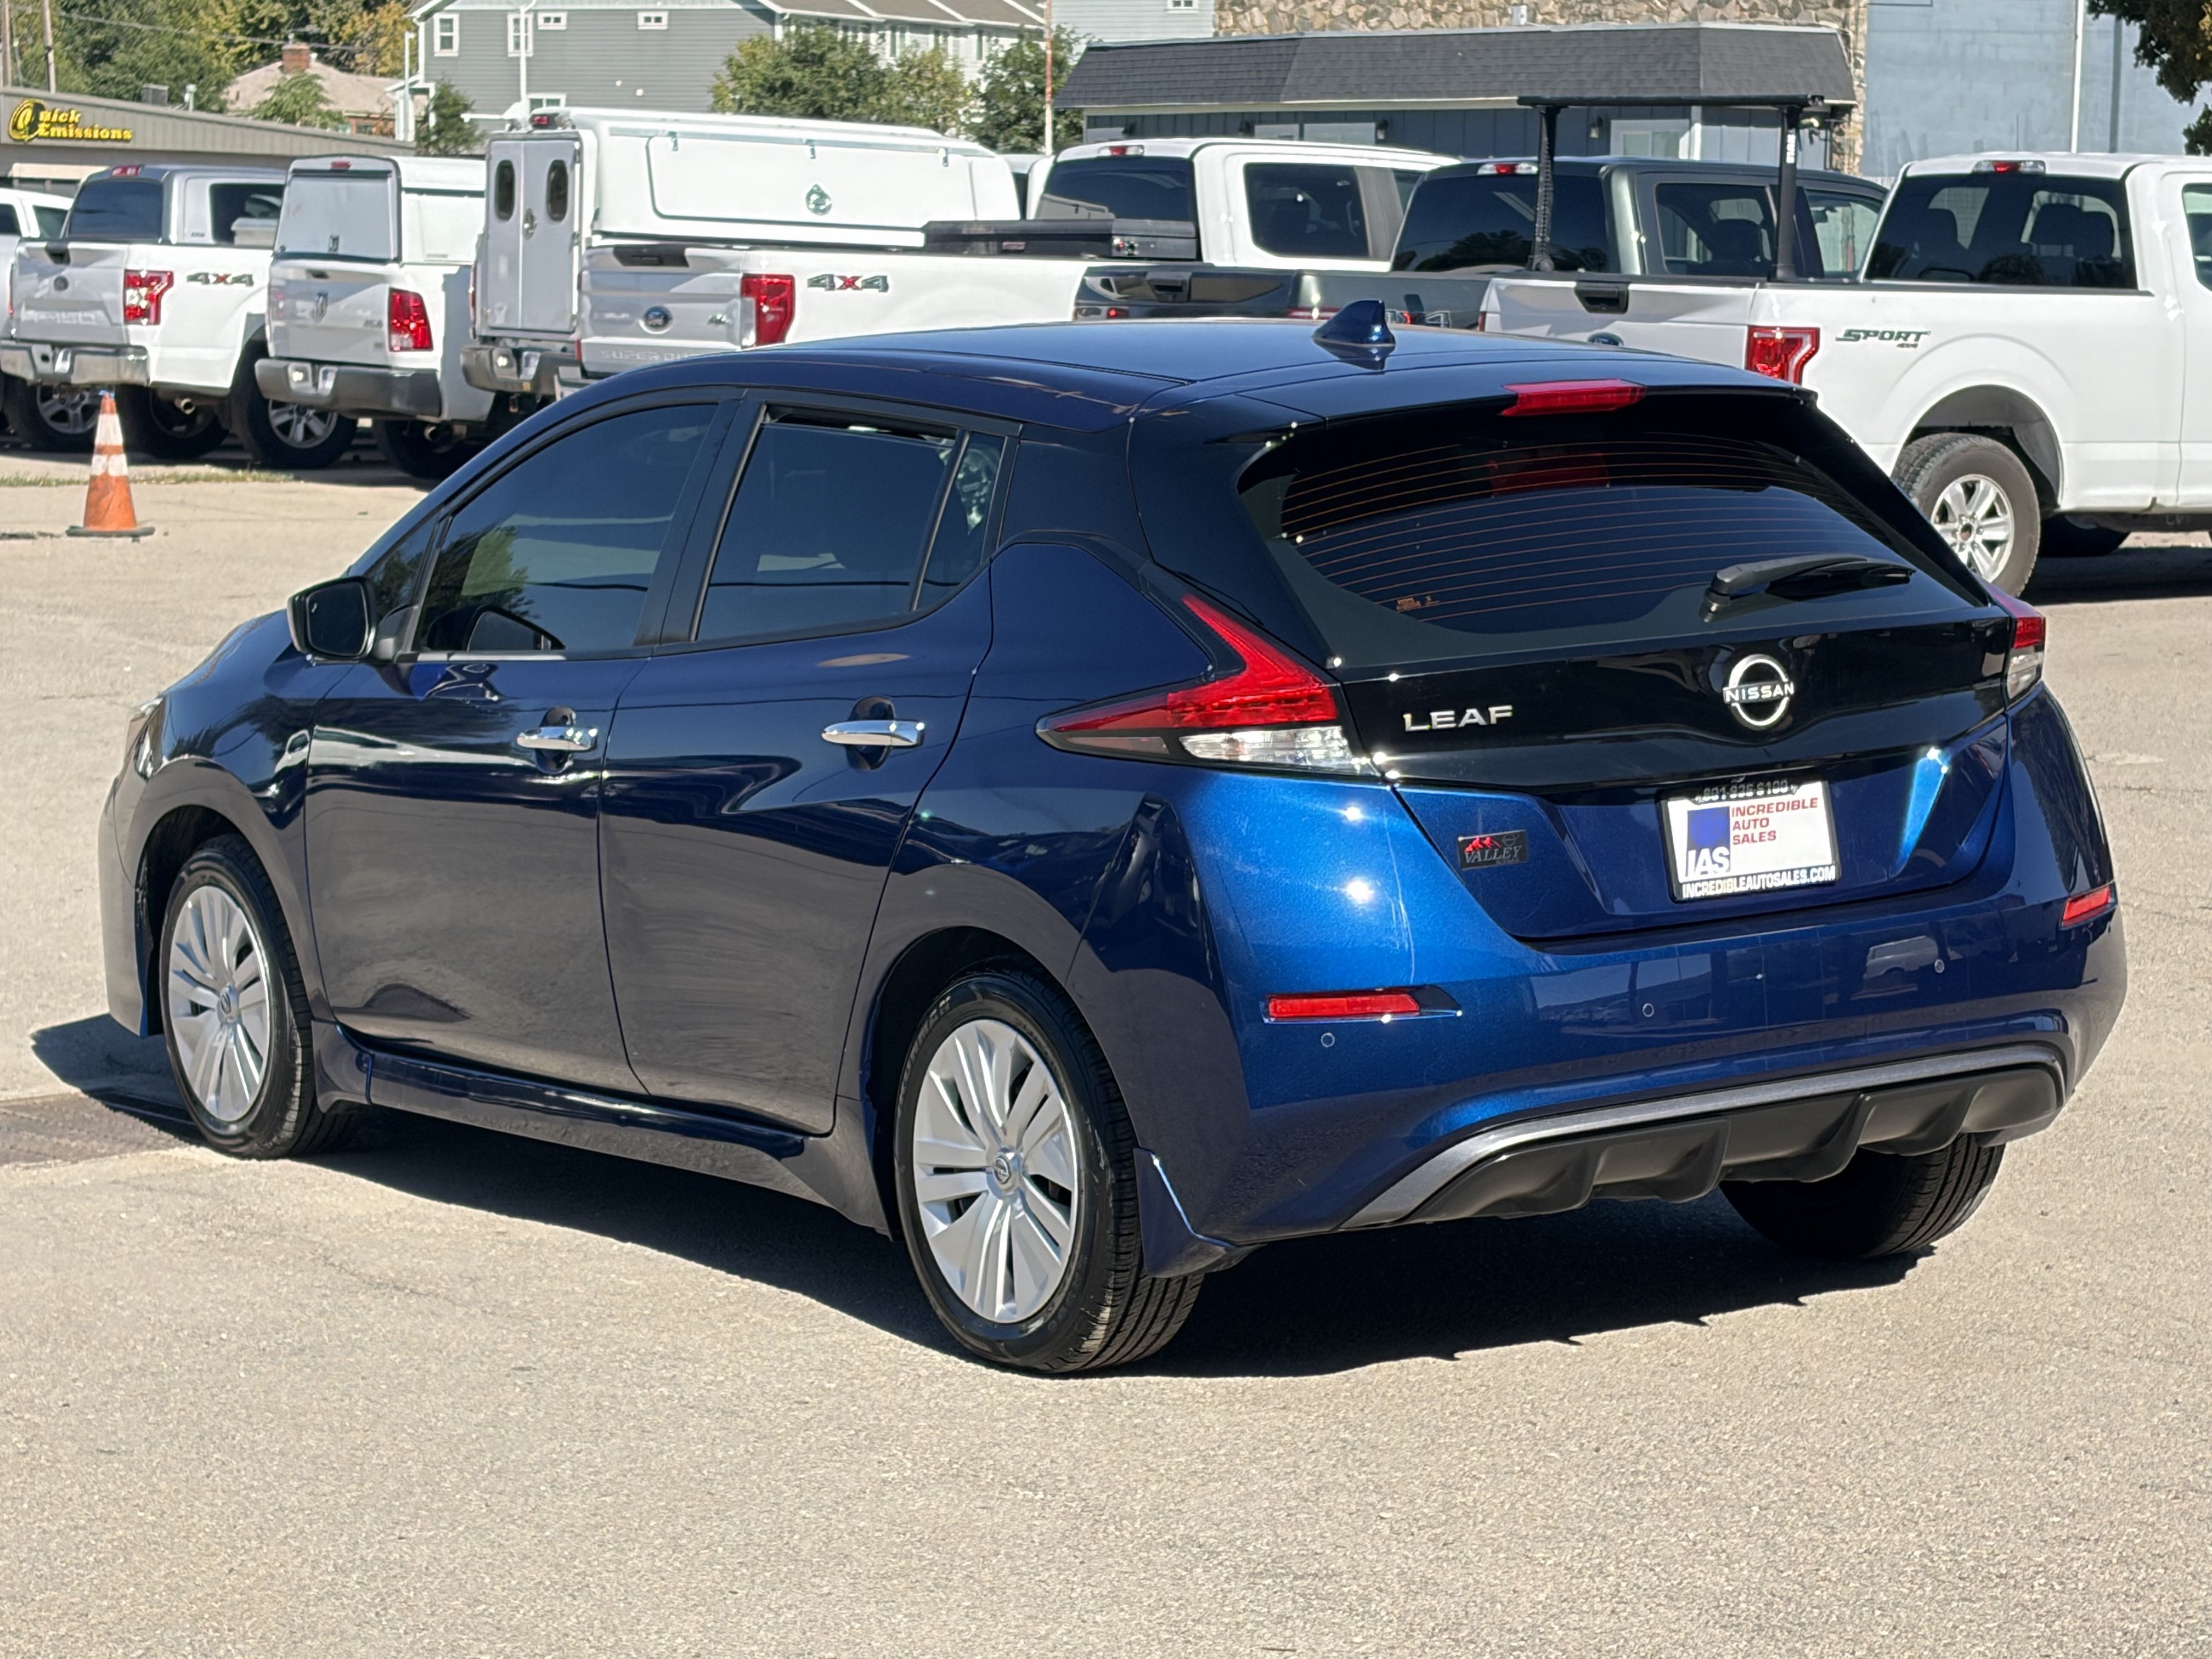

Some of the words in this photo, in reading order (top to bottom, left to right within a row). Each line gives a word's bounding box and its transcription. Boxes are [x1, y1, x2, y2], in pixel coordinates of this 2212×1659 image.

[38, 124, 132, 140] Emissions
[1835, 329, 1931, 342] SPORT
[1725, 682, 1795, 702] NISSAN
[1402, 704, 1513, 732] LEAF
[1731, 797, 1818, 817] INCREDIBLE
[1732, 817, 1770, 831] AUTO
[1732, 830, 1777, 845] SALES
[1465, 845, 1523, 864] VALLEY
[1685, 845, 1730, 877] IAS
[1682, 865, 1836, 899] INCREDIBLEAUTOSALES.COM
